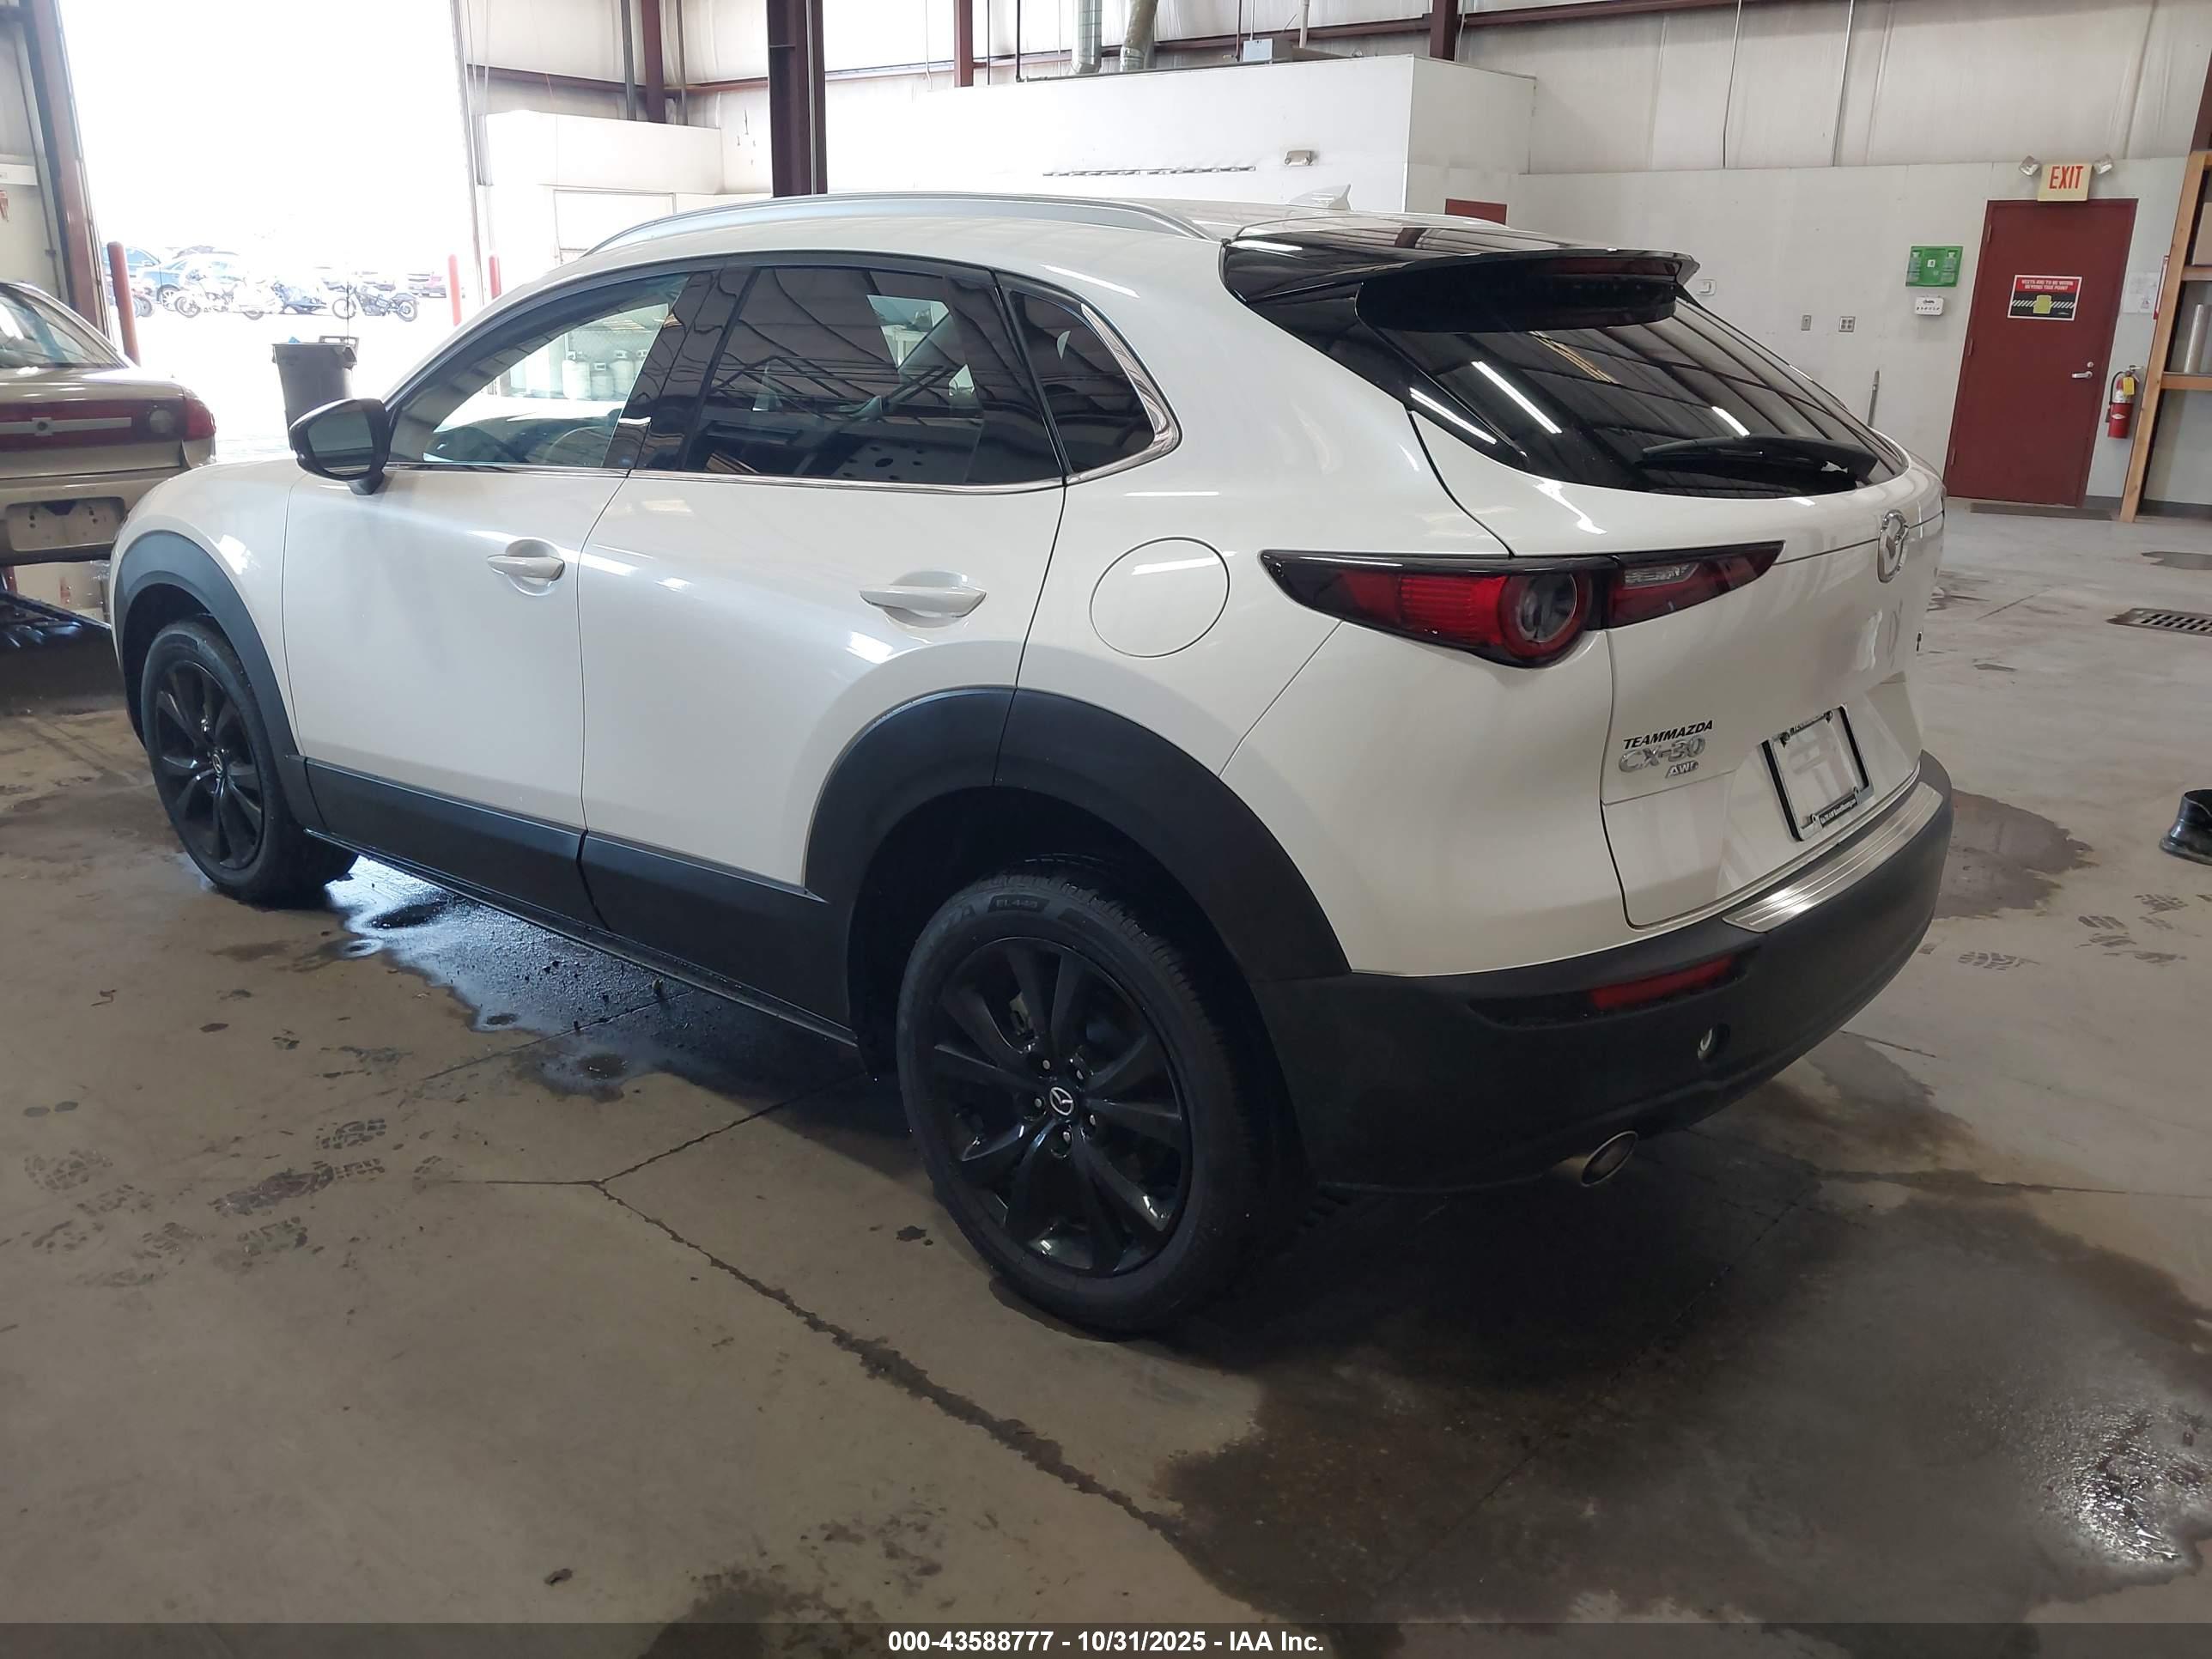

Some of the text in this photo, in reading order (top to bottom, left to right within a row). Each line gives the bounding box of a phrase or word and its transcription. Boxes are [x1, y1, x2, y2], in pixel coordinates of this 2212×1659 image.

[2049, 166, 2083, 189] EXIT
[1623, 720, 1713, 750] TEAMMAZDA
[1618, 735, 1706, 773] CX-30
